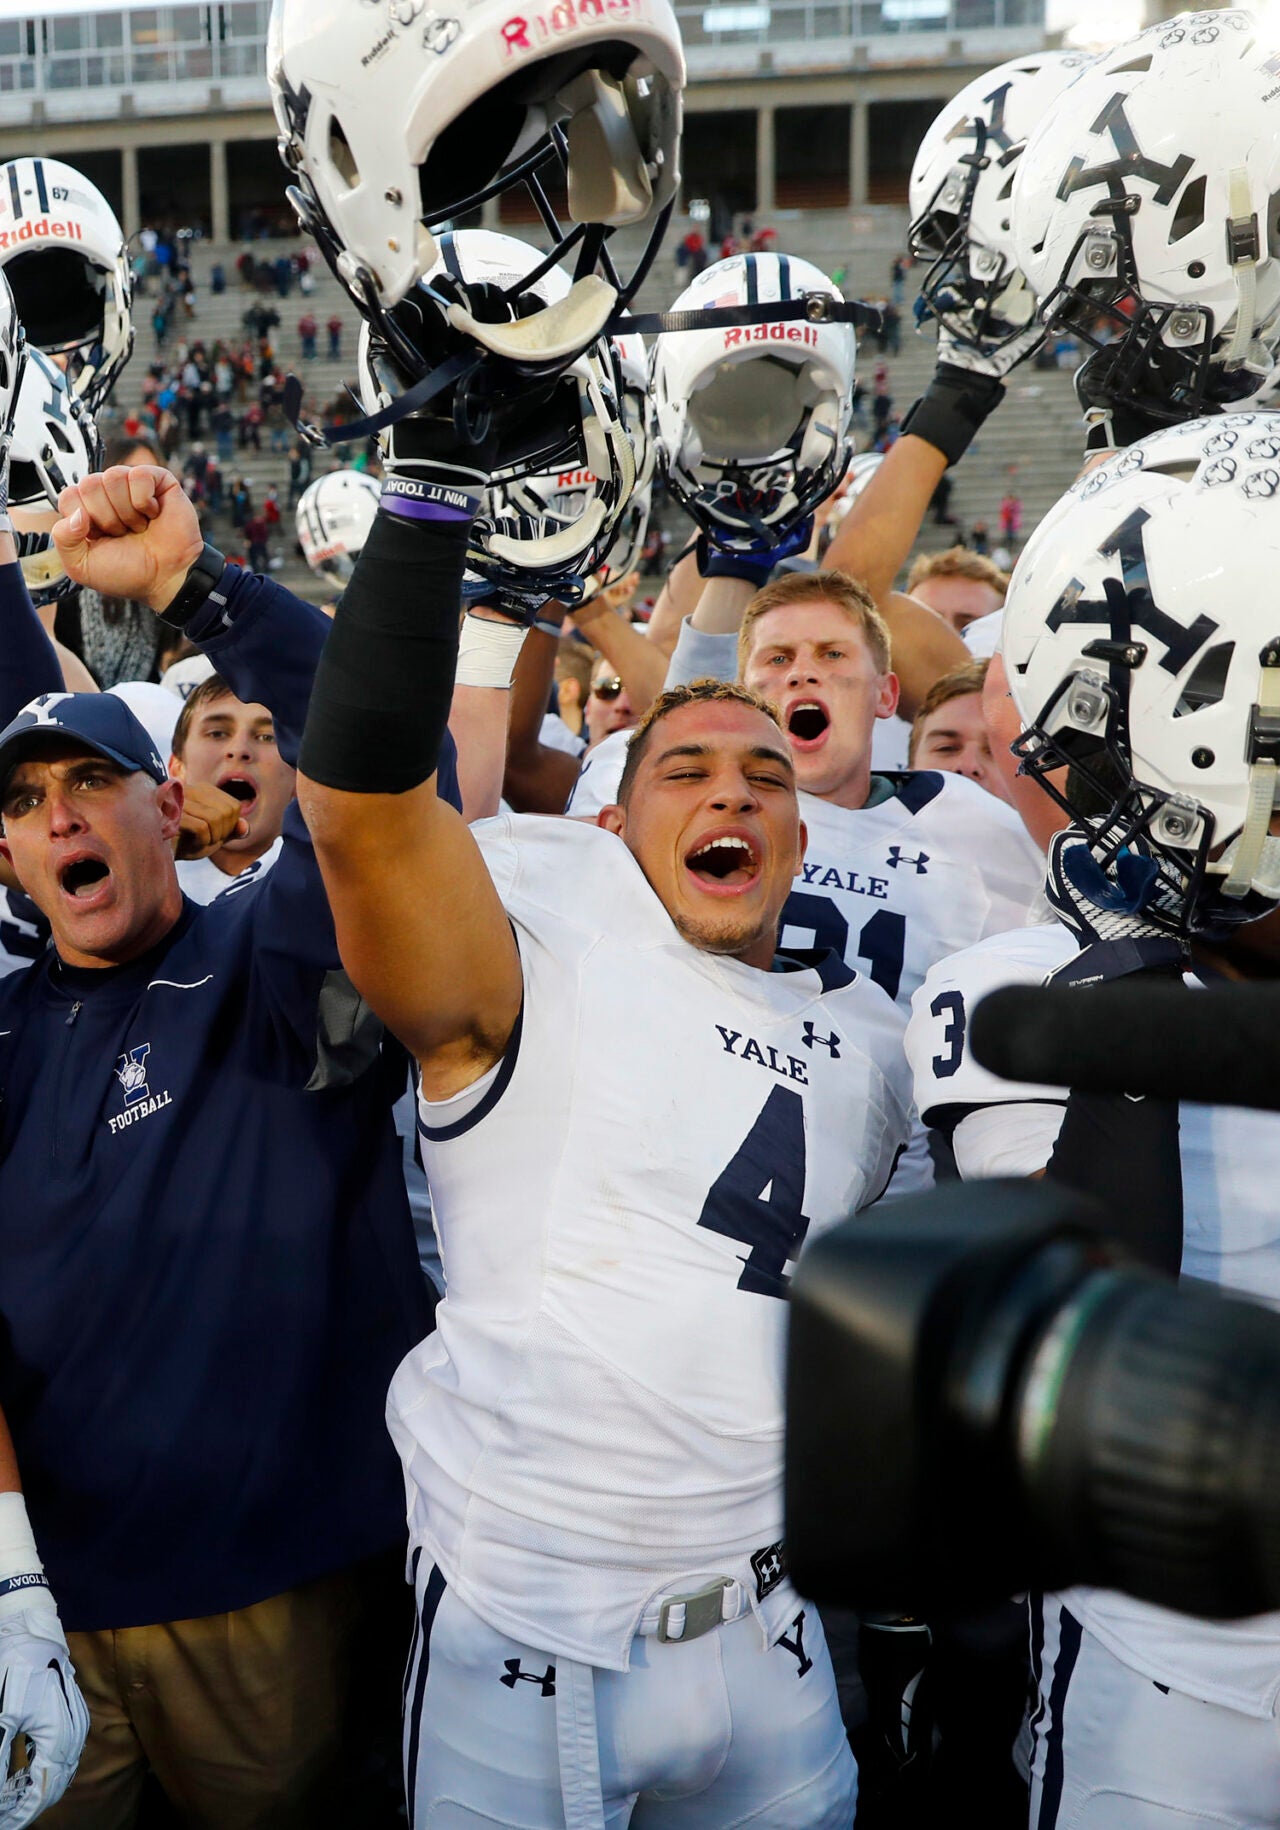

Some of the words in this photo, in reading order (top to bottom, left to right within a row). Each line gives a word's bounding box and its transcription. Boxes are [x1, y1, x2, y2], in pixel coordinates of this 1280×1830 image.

[361, 28, 398, 68] Riddell
[52, 187, 69, 201] 67
[724, 322, 818, 350] Riddell
[385, 480, 425, 497] TODAY
[427, 487, 442, 500] IT
[444, 490, 468, 508] WIN
[1045, 507, 1220, 677] Y
[17, 692, 75, 726] Y
[802, 863, 889, 899] YALE
[930, 990, 966, 1079] 3
[715, 1024, 809, 1085] YALE
[108, 1090, 173, 1134] FOOTBALL
[696, 1083, 811, 1300] 4
[8, 1574, 41, 1590] TODAY
[773, 1609, 813, 1679] Y
